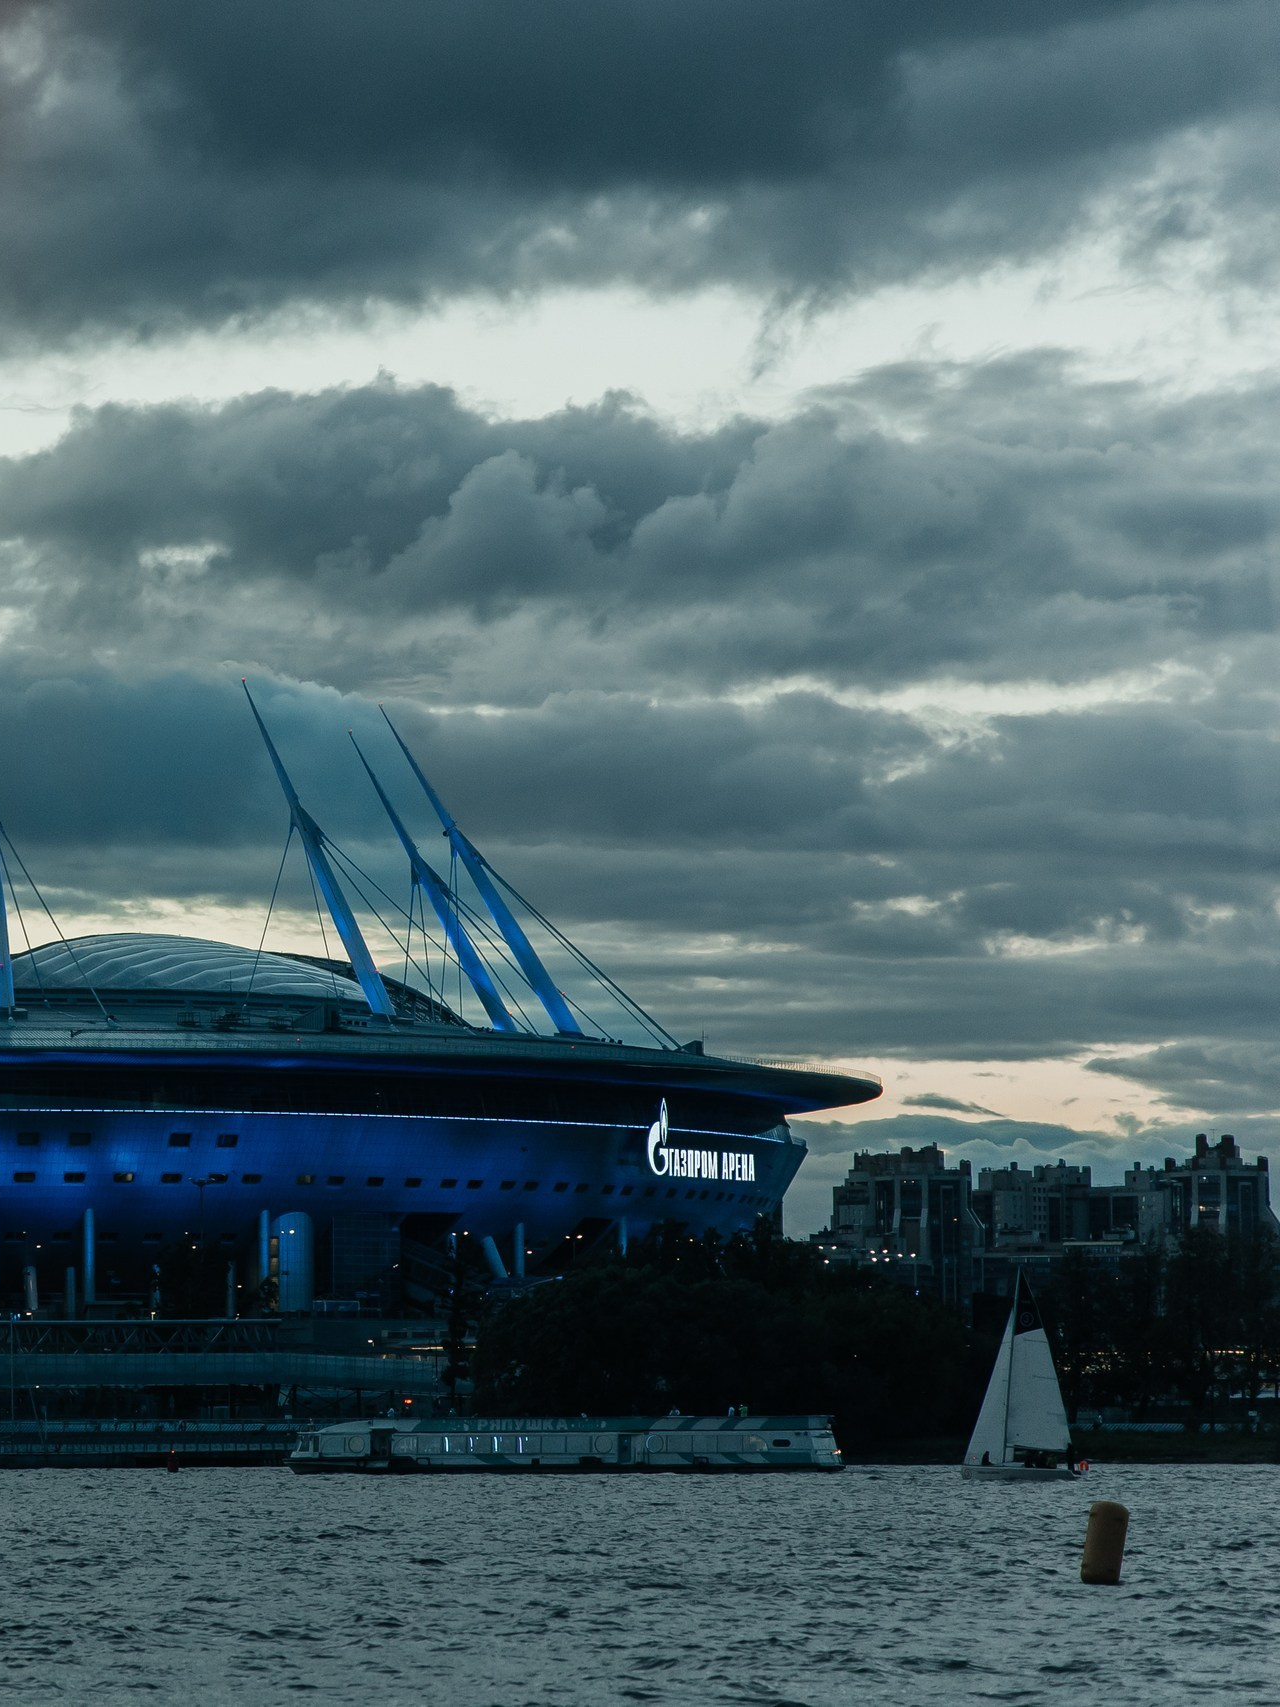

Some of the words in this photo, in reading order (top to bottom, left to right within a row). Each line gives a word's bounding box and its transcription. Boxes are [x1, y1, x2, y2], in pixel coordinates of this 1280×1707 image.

[669, 1148, 719, 1180] ГАЗПРОМ
[722, 1152, 756, 1182] АРЕНА
[477, 1418, 568, 1431] РЯПУШКА
